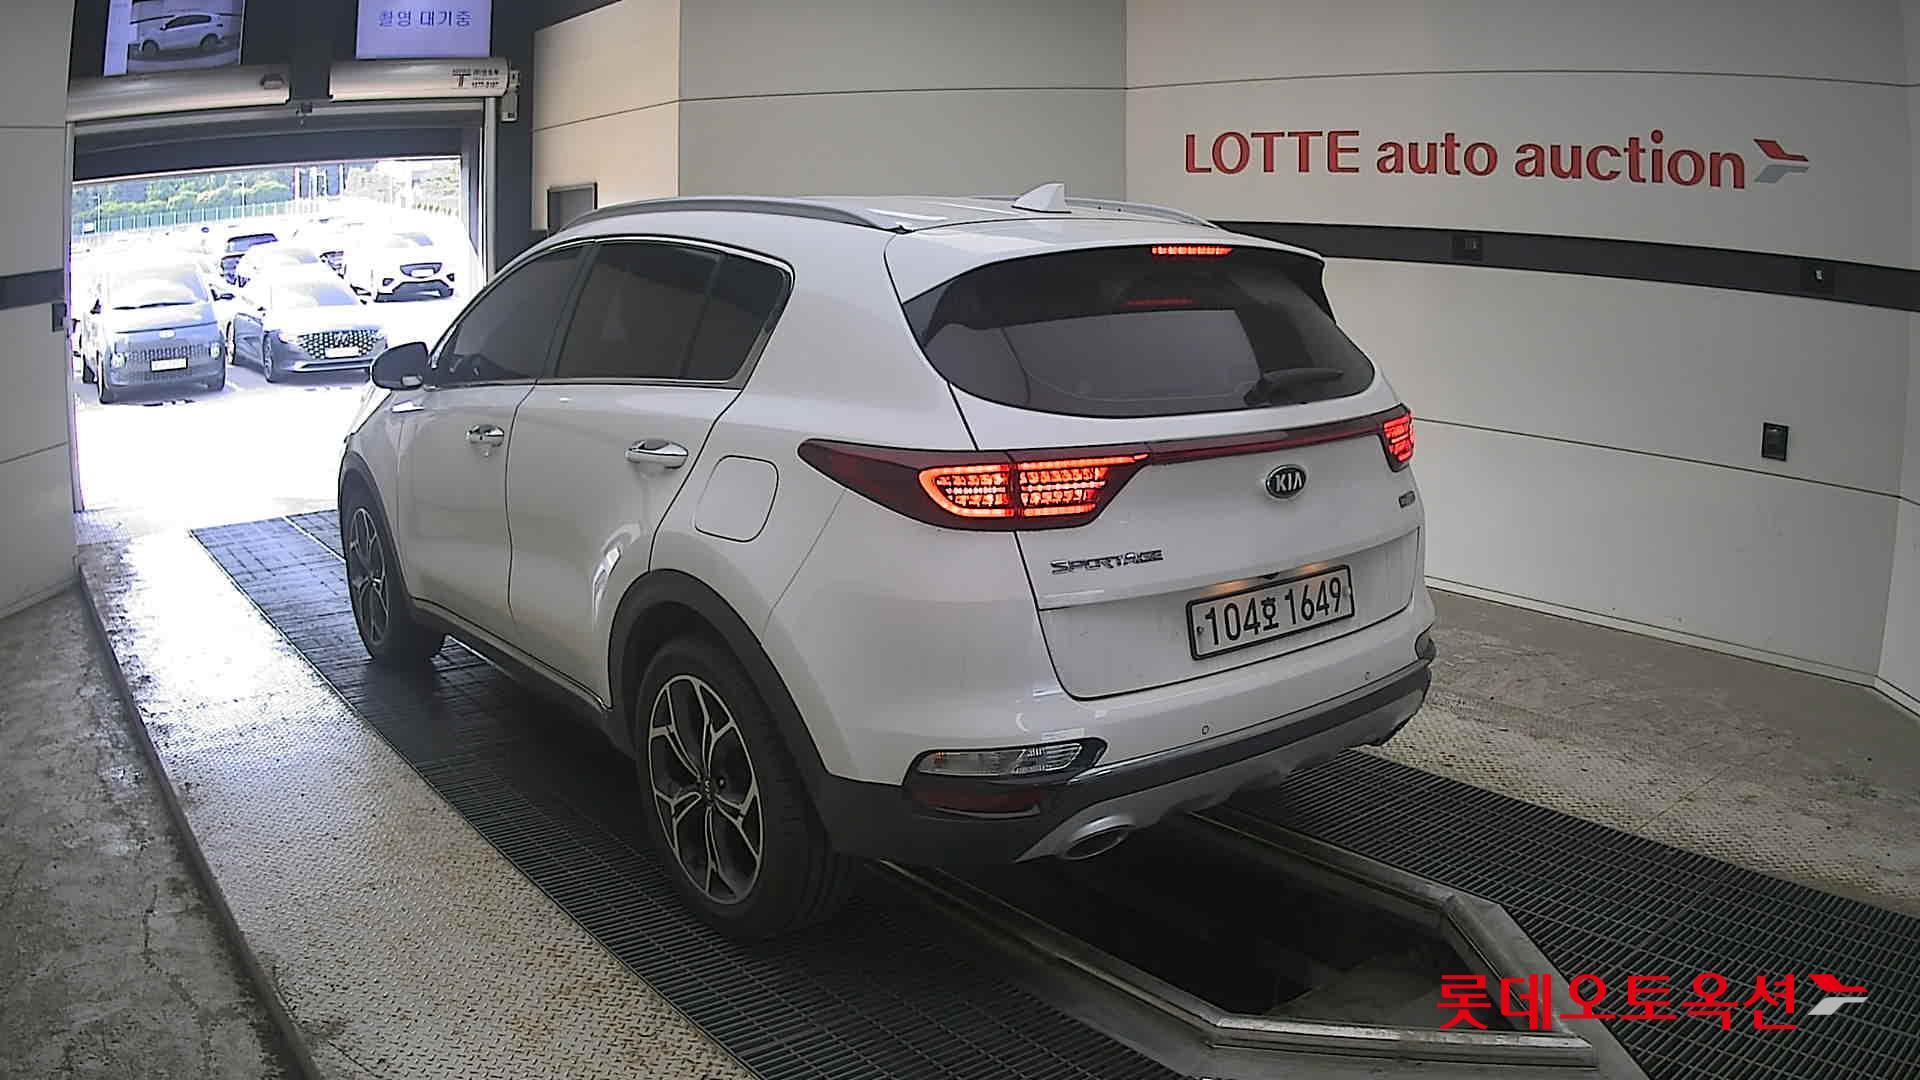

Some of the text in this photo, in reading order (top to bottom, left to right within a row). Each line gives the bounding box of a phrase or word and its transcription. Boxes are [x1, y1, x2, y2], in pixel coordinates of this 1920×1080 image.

[420, 10, 472, 27] 대기중
[1185, 130, 1746, 190] LOTTE auto auction
[1050, 549, 1164, 575] SPORTAGE
[1204, 576, 1342, 646] 104호 1649
